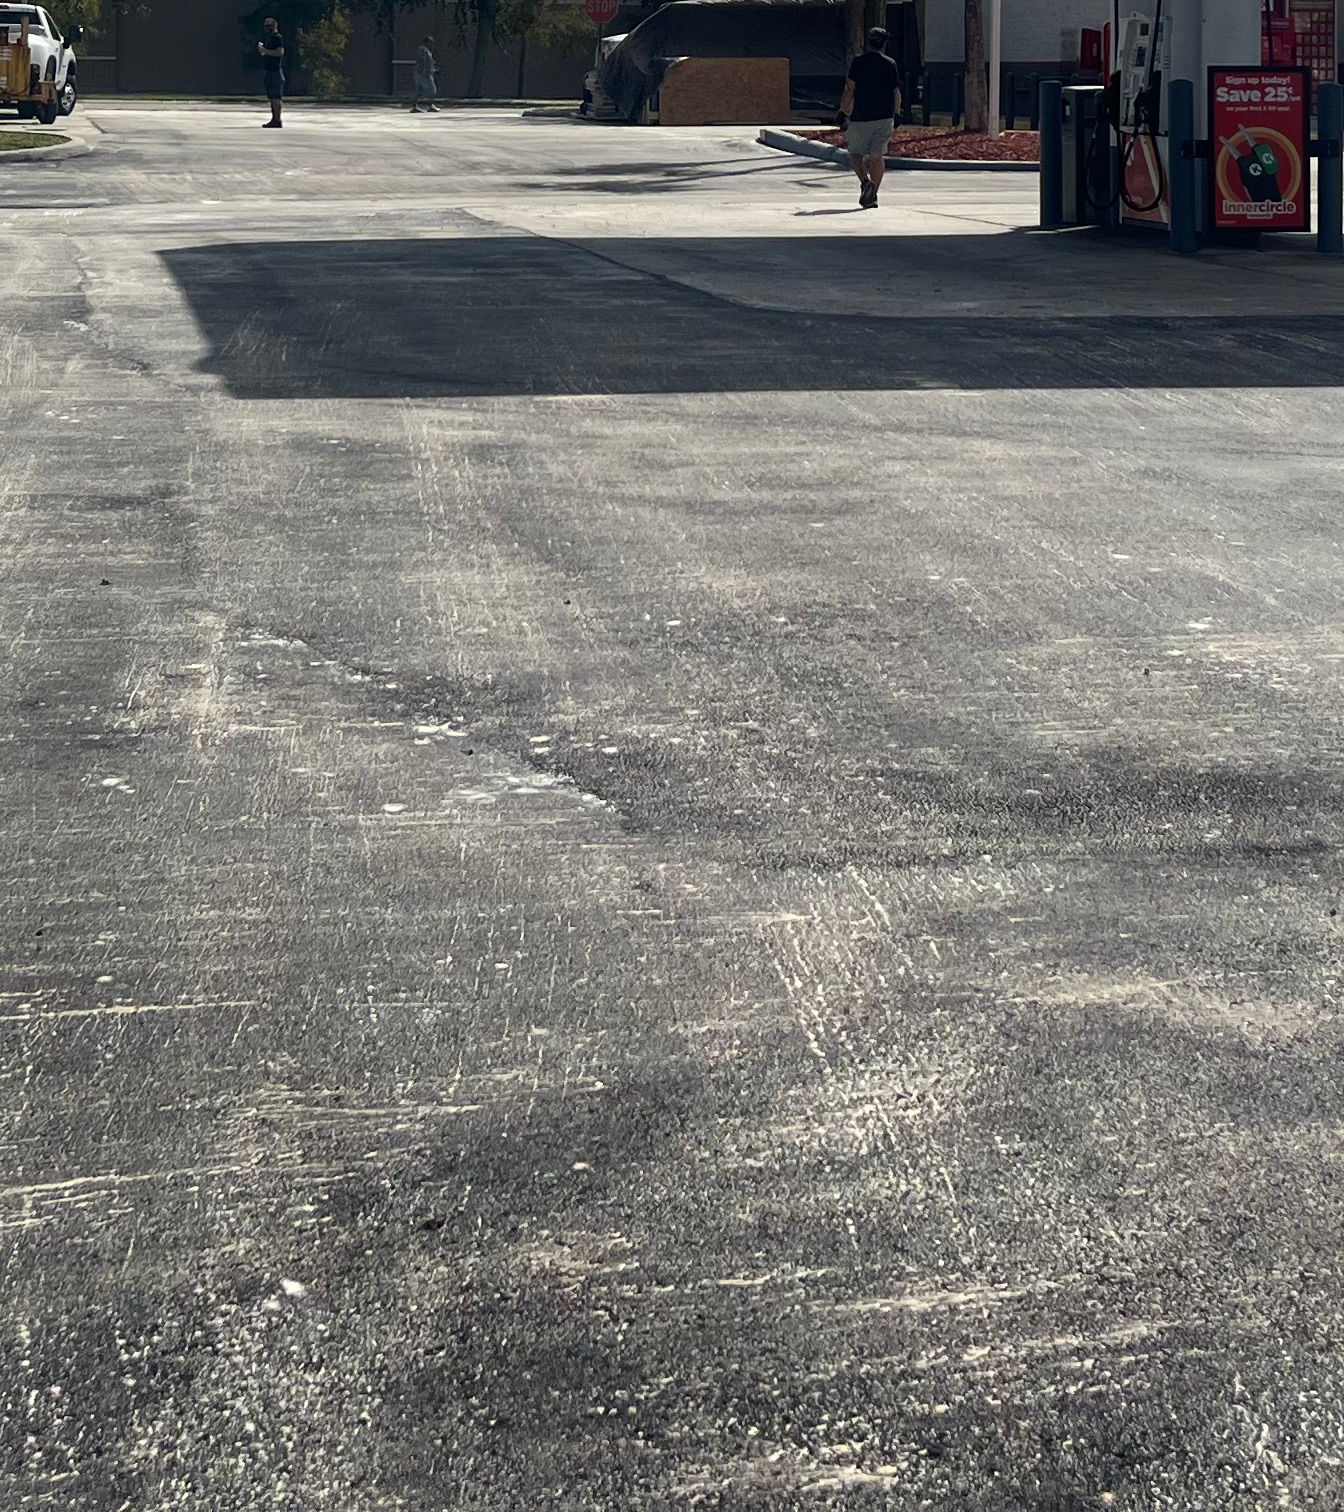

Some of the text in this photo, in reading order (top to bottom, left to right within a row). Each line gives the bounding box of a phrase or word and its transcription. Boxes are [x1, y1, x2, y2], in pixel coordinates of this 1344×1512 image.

[587, 0, 617, 13] STOP
[1216, 87, 1261, 102] Save
[1224, 199, 1296, 214] innercircle
